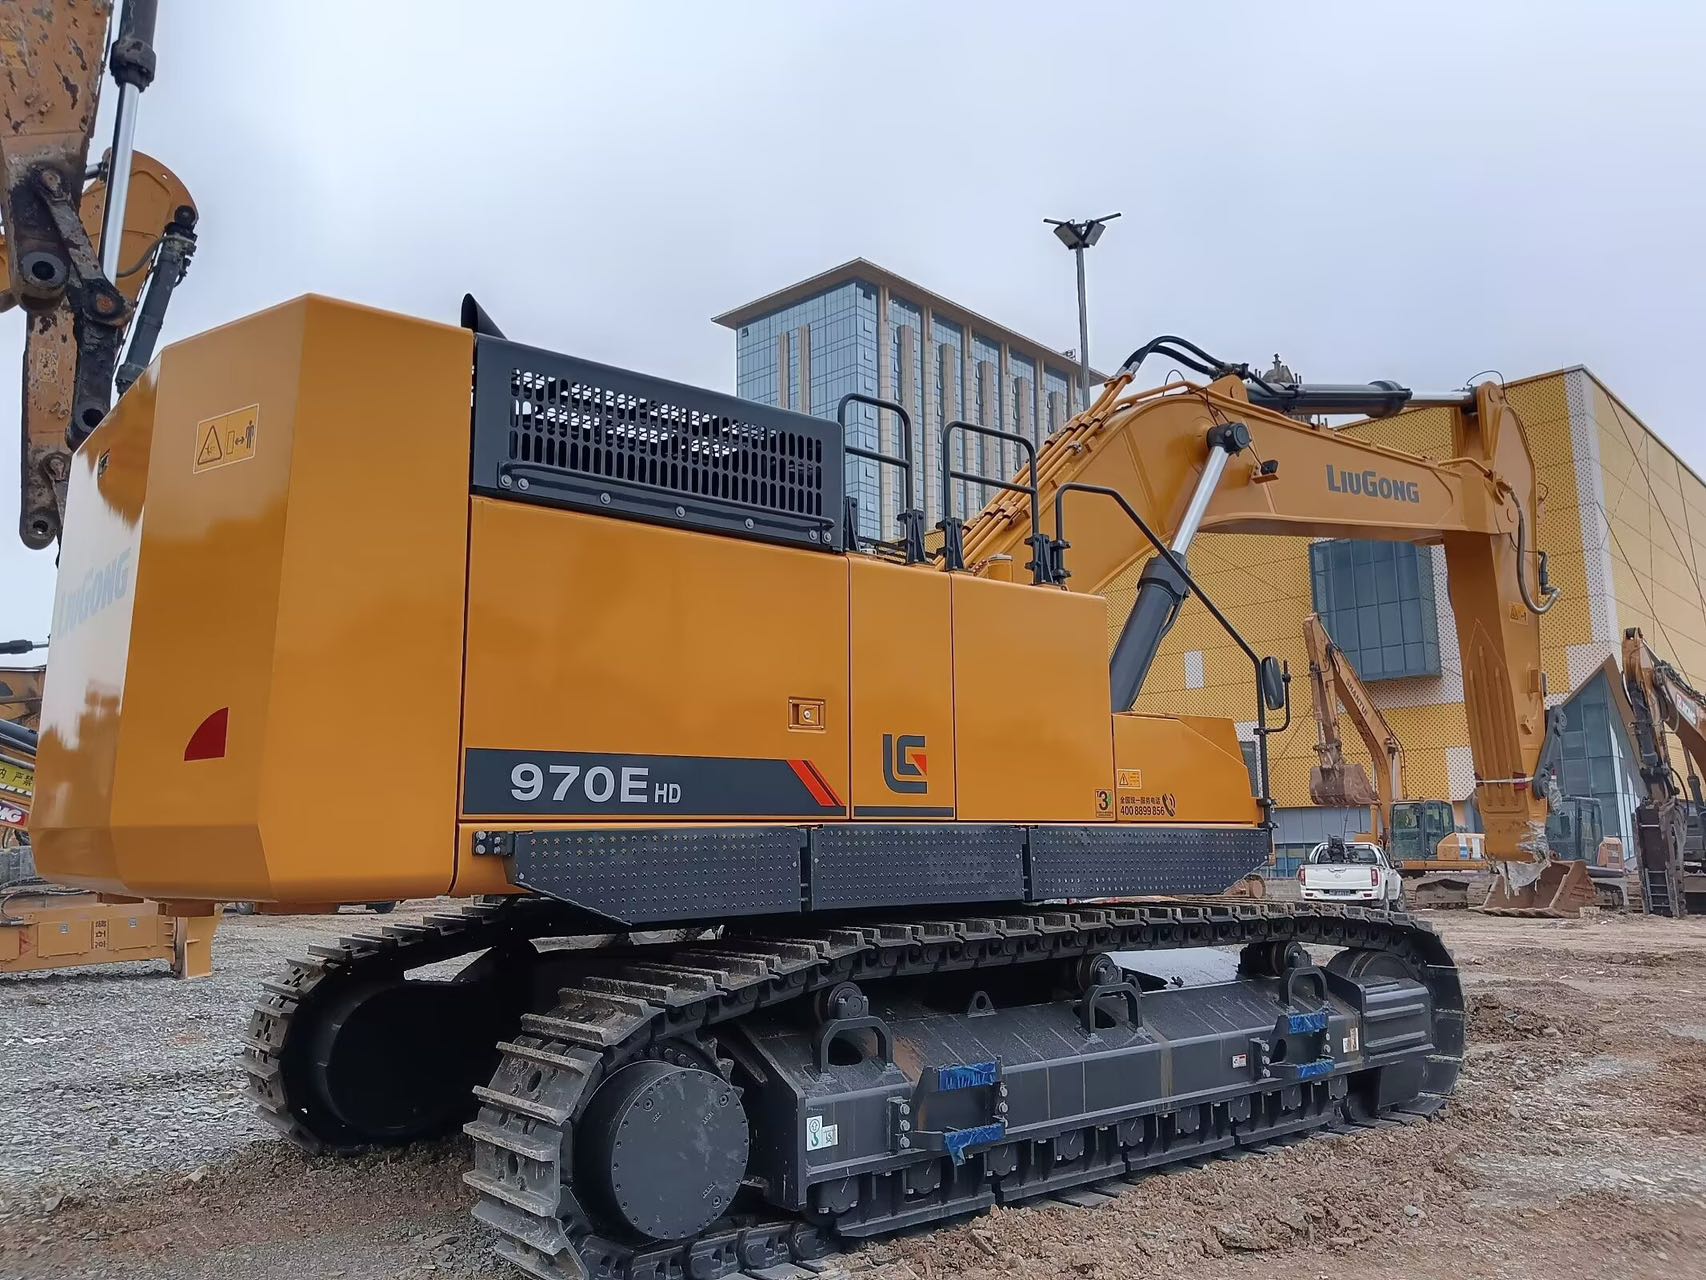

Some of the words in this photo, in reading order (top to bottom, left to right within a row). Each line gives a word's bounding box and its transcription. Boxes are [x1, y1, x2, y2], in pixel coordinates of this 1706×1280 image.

[1345, 678, 1368, 717] SHANTUI
[511, 763, 649, 803] 970E
[654, 782, 682, 804] HD
[1120, 805, 1134, 816] 400
[1134, 805, 1152, 816] 8899
[1152, 806, 1165, 816] 856
